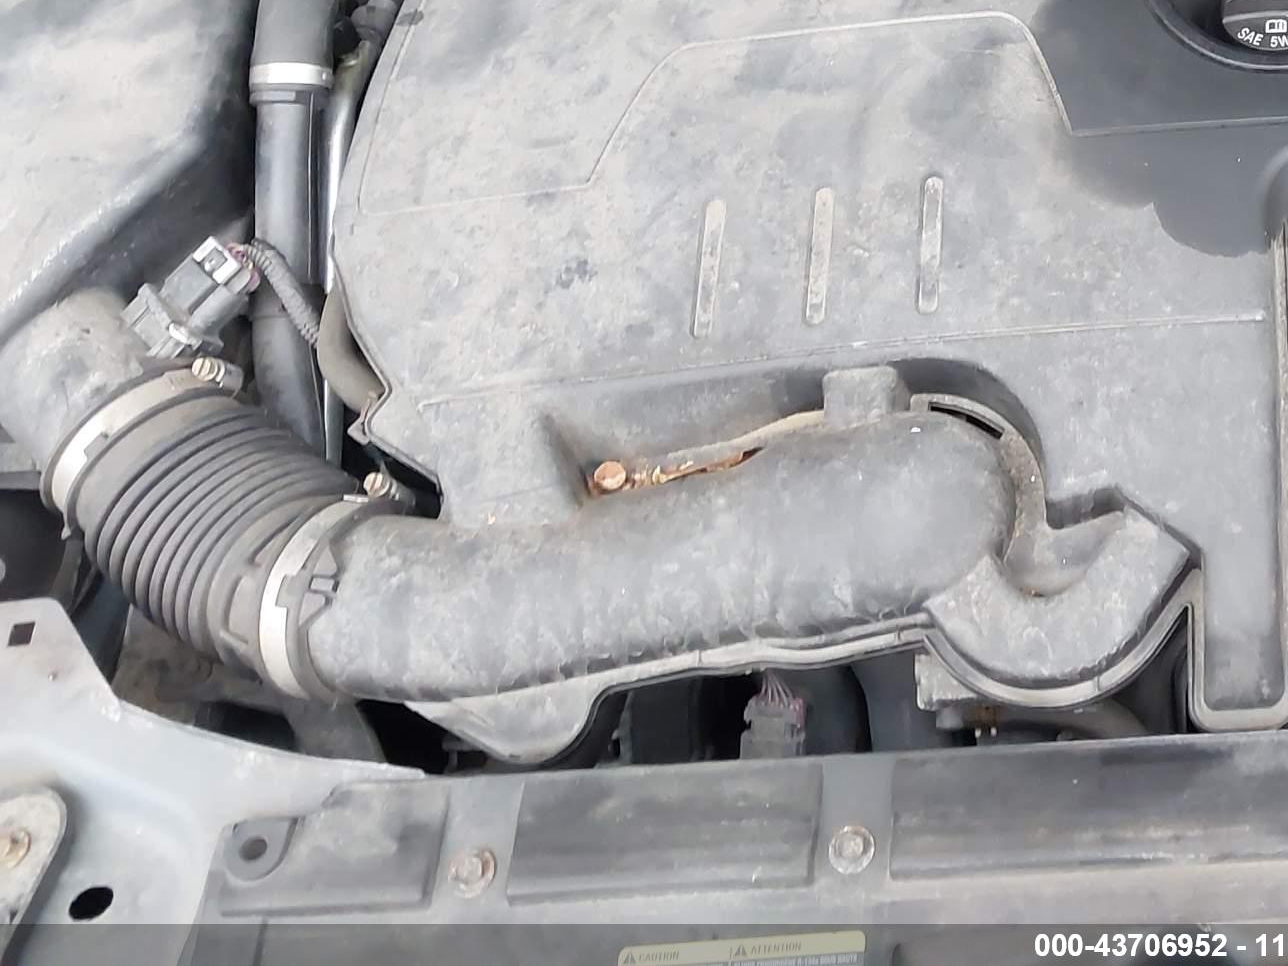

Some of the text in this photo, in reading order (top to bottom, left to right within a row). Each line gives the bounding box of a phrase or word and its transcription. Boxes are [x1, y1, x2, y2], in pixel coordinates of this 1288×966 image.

[1237, 27, 1264, 47] SAE
[751, 940, 802, 955] ATTENTION
[638, 951, 680, 963] CAUTION
